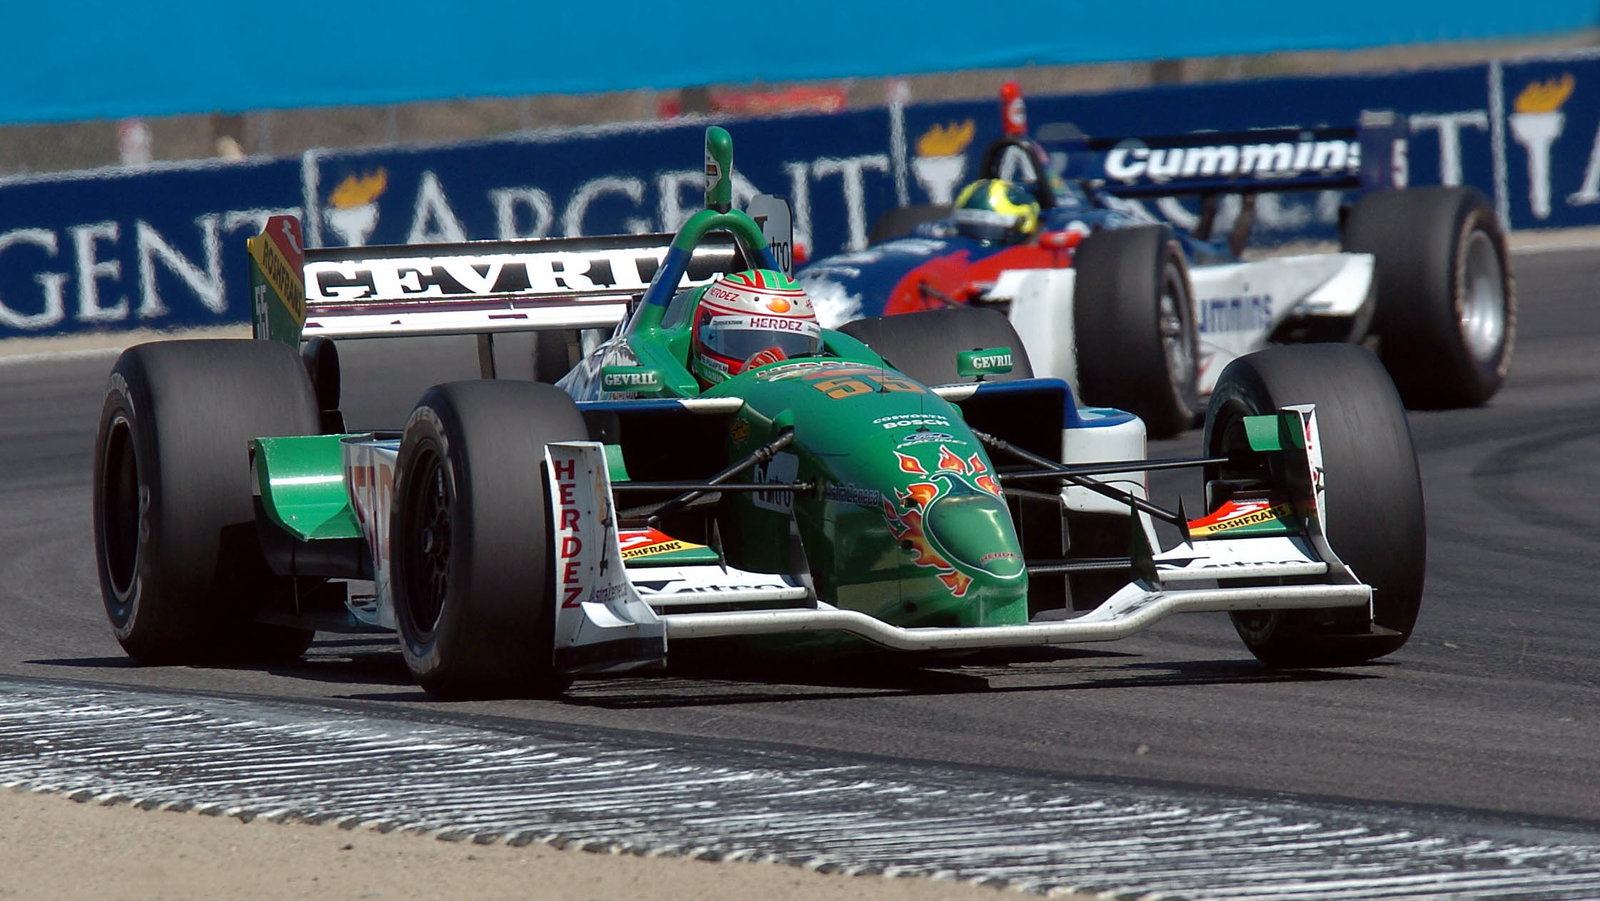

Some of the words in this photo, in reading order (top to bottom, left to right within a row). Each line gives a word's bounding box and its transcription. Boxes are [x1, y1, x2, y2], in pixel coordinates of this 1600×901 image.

[710, 287, 741, 302] HERDEZ
[1198, 283, 1273, 334] ummins
[749, 317, 803, 331] HERDEZ
[972, 354, 1013, 369] GEVRIL
[604, 371, 657, 386] GEVRIL
[812, 374, 928, 400] 55
[872, 413, 948, 424] COSWORTH
[882, 419, 950, 429] BOSCH
[1207, 505, 1287, 533] ROSHFRANS
[555, 459, 583, 609] HERDEZ
[621, 542, 682, 558] OSHFRANS
